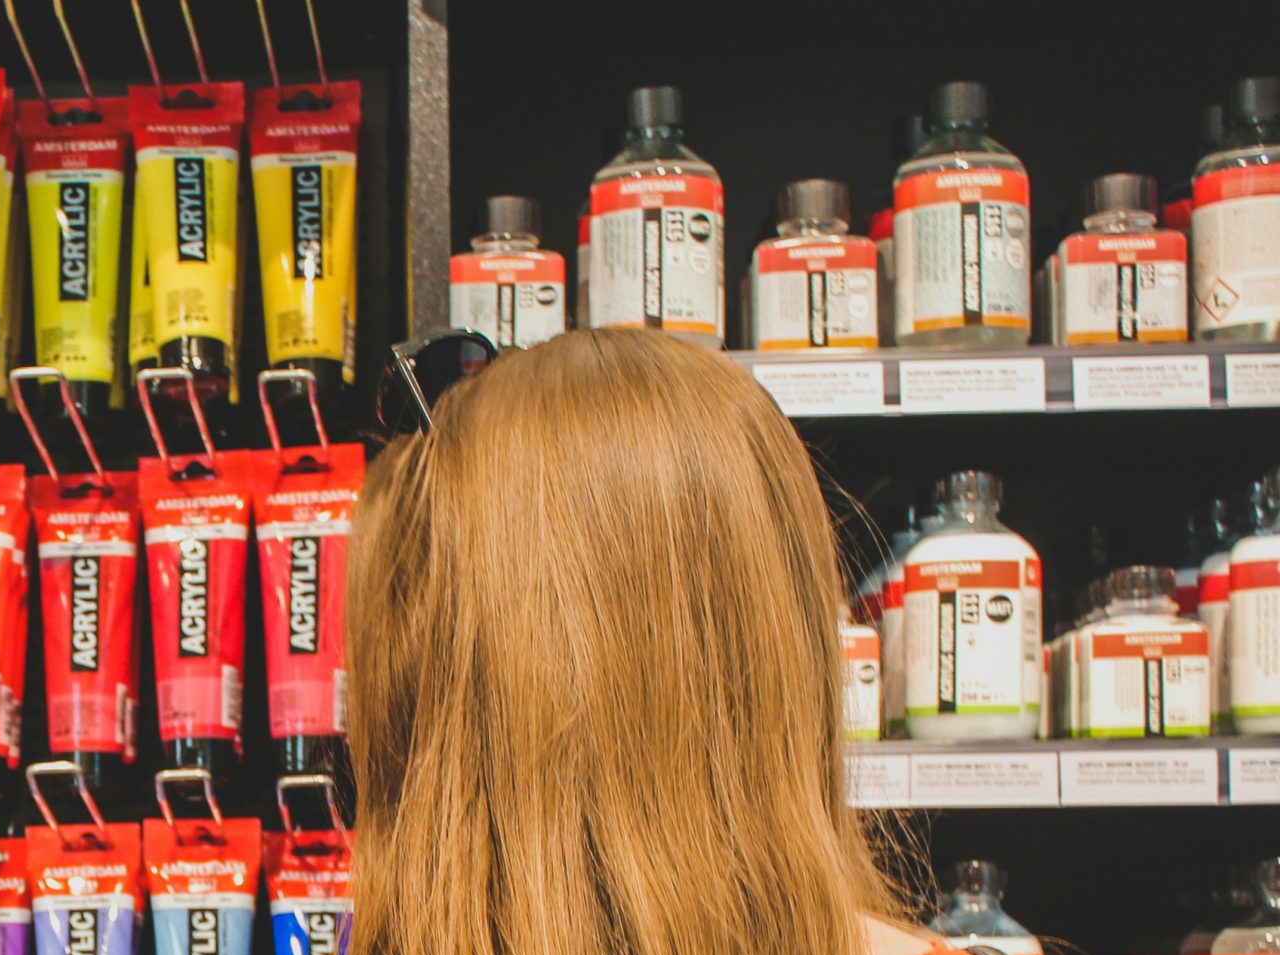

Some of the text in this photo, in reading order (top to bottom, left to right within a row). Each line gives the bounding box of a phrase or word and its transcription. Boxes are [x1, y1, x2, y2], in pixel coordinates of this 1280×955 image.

[63, 187, 86, 298] ACRYLIC
[179, 161, 206, 260] ACRYLIC
[297, 171, 323, 278] ACRYLIC
[73, 557, 99, 669] ACRYLIC
[180, 540, 208, 655] ACRYLIC
[290, 538, 318, 651] ACRYLIC
[43, 865, 127, 878] AMSTERDAM
